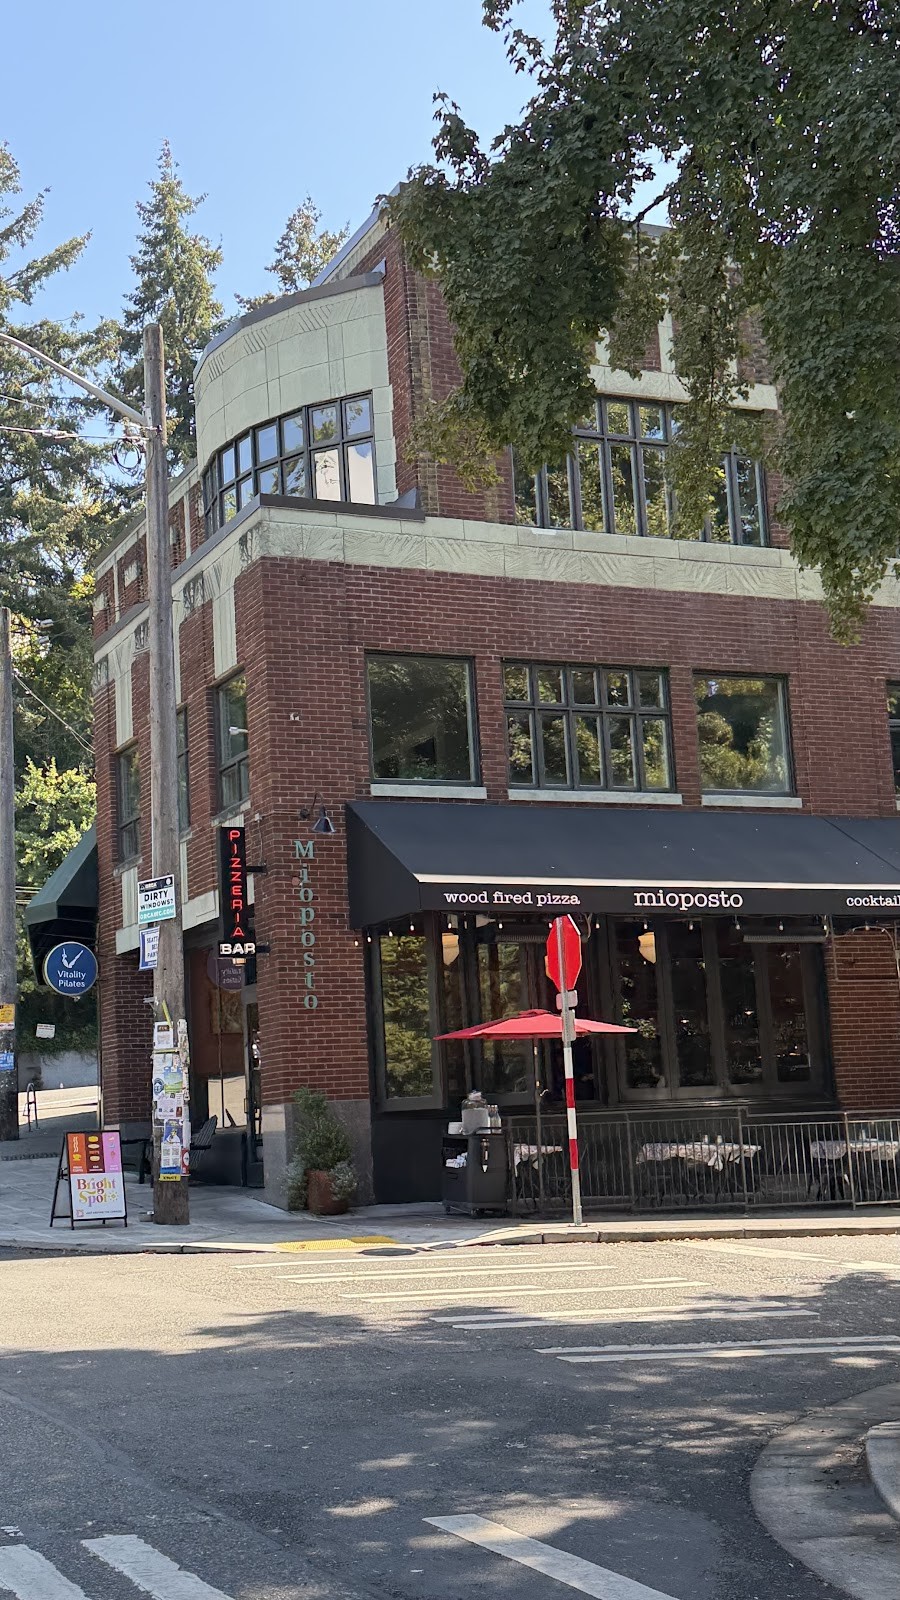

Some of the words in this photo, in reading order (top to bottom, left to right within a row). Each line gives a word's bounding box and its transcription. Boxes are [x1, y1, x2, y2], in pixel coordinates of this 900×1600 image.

[229, 830, 244, 937] PIZZERIA
[144, 889, 169, 902] DIRTY
[443, 890, 489, 904] wood
[492, 891, 533, 905] fired
[536, 892, 581, 907] pizza
[634, 889, 743, 911] mioposto
[140, 898, 174, 911] WINDOWS?
[294, 840, 318, 1010] Mioposto
[219, 942, 256, 955] BAR
[57, 970, 87, 980] Vitality
[58, 979, 86, 988] Pilates
[77, 1178, 117, 1195] Bright
[79, 1190, 108, 1207] Spot
